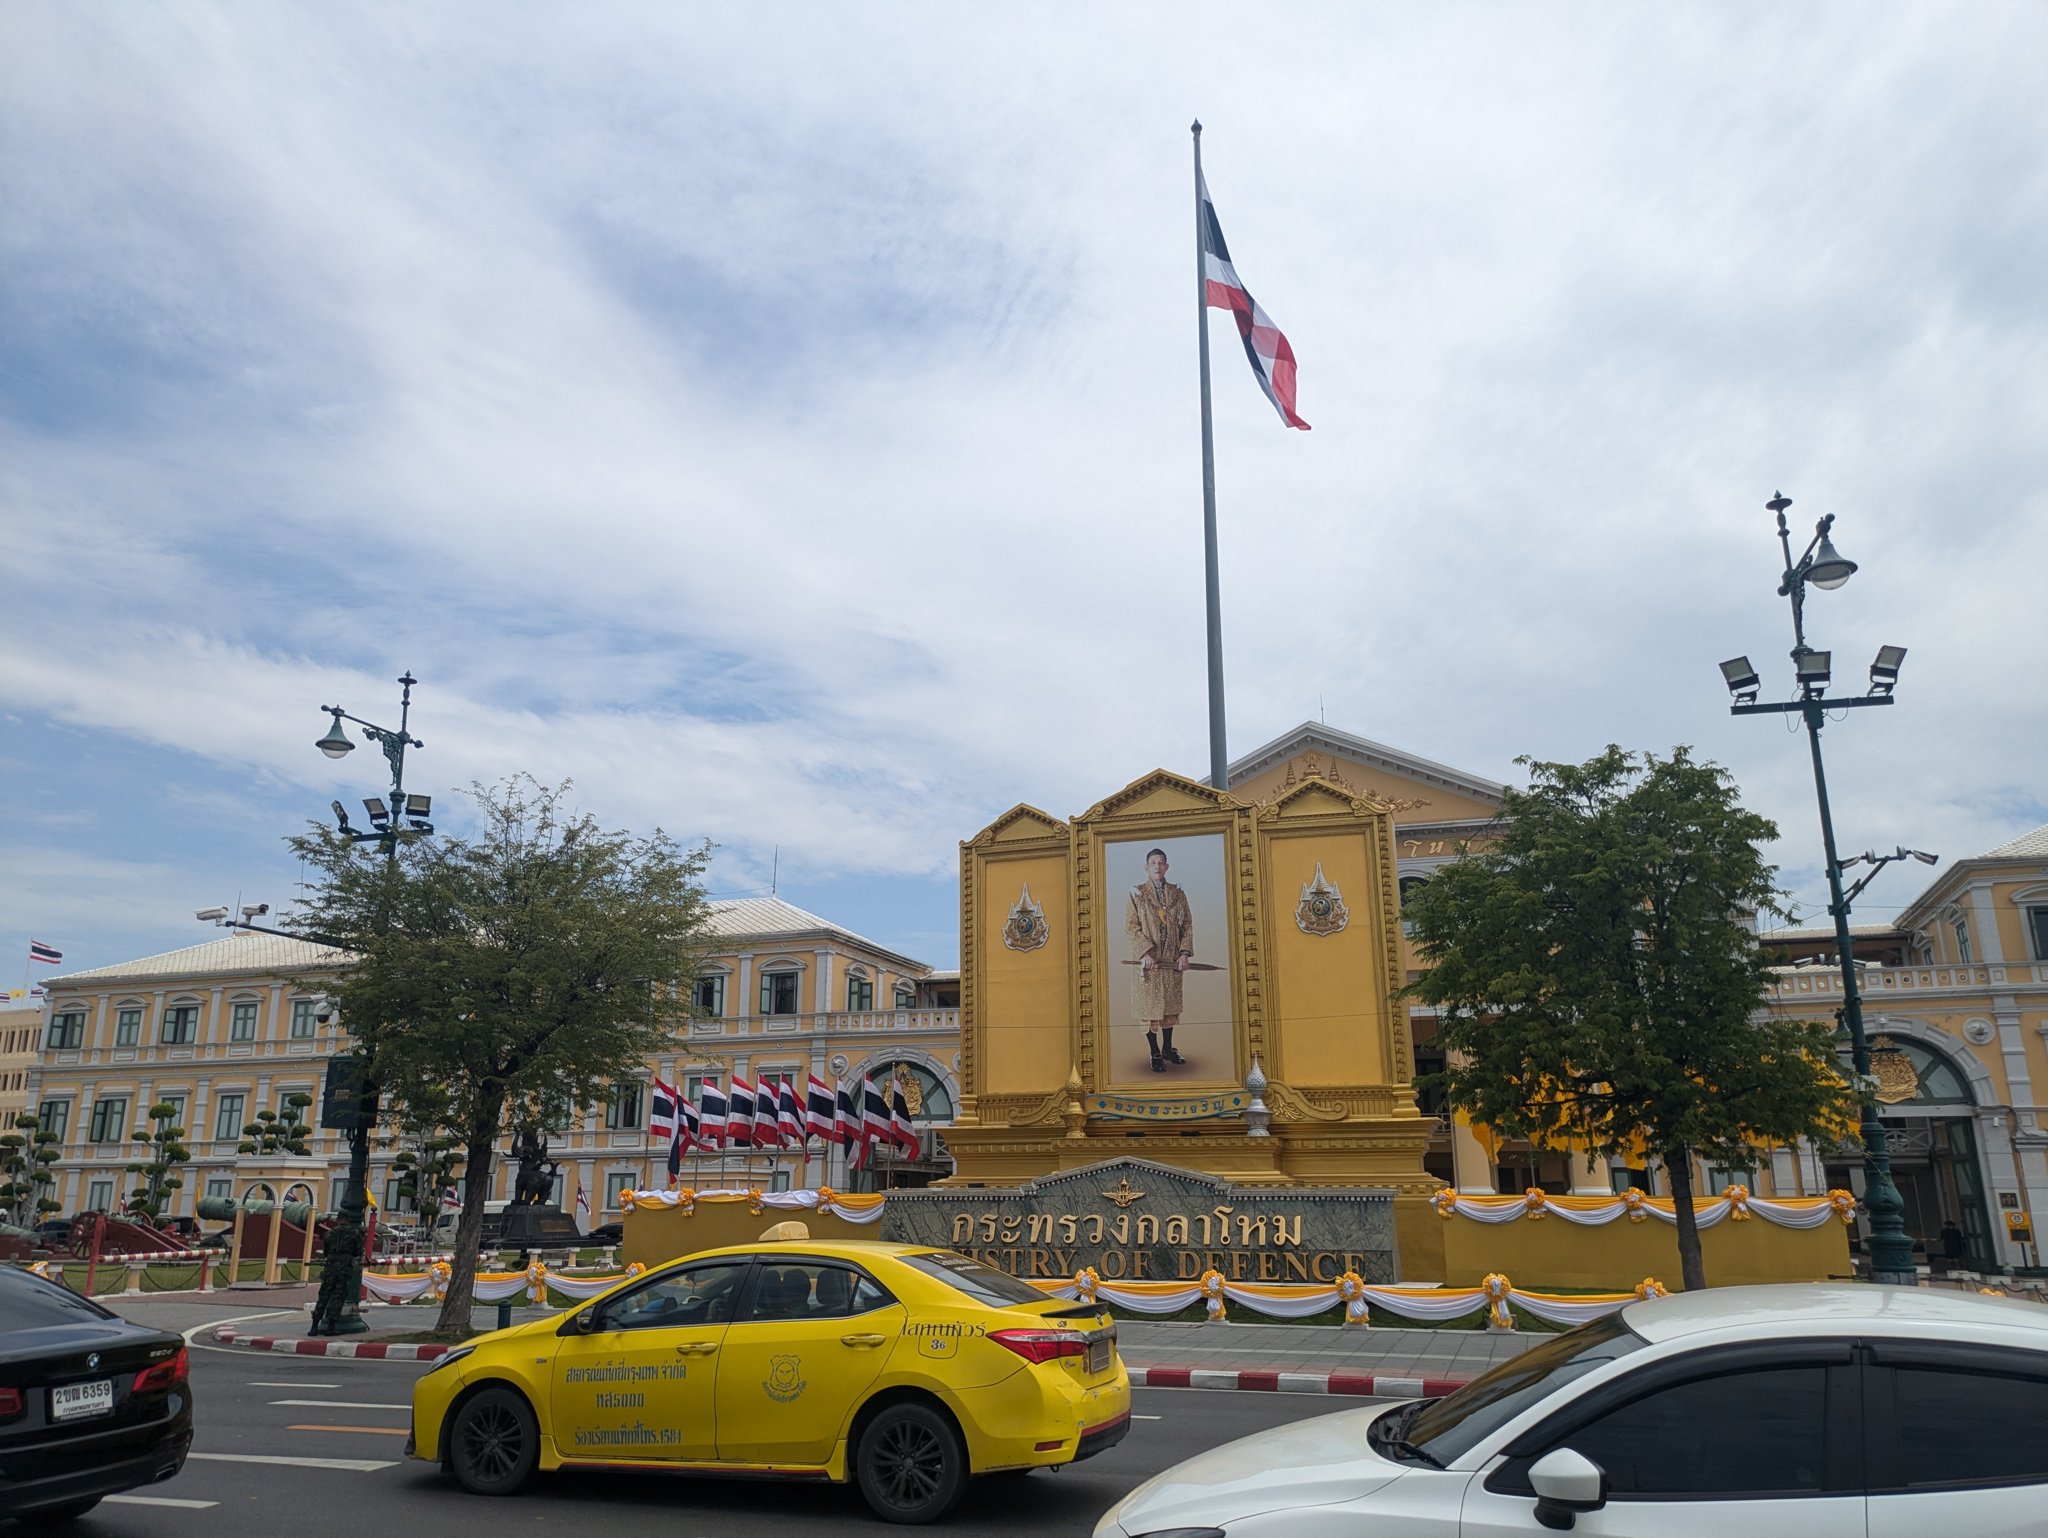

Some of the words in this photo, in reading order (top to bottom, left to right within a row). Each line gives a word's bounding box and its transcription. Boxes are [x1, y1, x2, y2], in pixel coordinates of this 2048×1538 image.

[1114, 1099, 1226, 1116] ทรงพระเจริญ
[952, 1204, 1301, 1246] กระทรวงกลาโหม
[1101, 1250, 1152, 1279] OF
[1177, 1250, 1367, 1282] DEFENCE
[930, 1338, 946, 1350] 36
[82, 1382, 111, 1400] 6359
